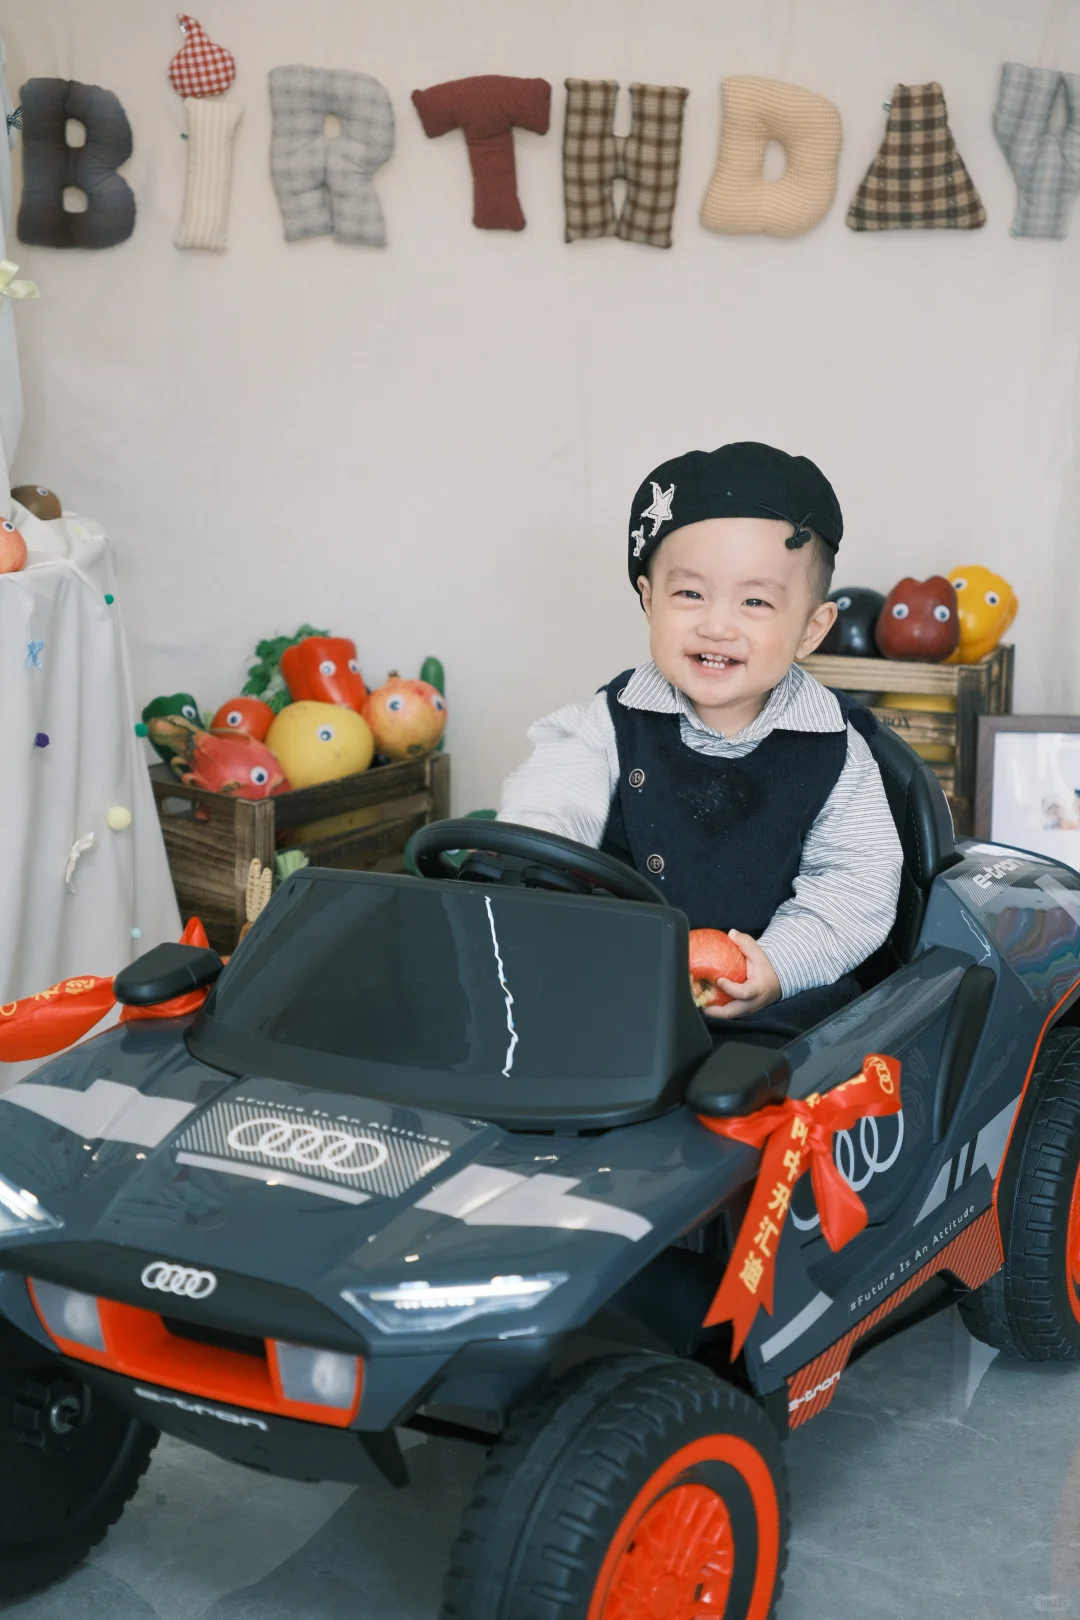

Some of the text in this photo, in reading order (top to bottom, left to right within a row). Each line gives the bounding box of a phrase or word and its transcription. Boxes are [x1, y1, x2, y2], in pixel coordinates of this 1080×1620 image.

[972, 858, 1024, 889] e-tron
[849, 1204, 975, 1312] #Future Is An Attitude
